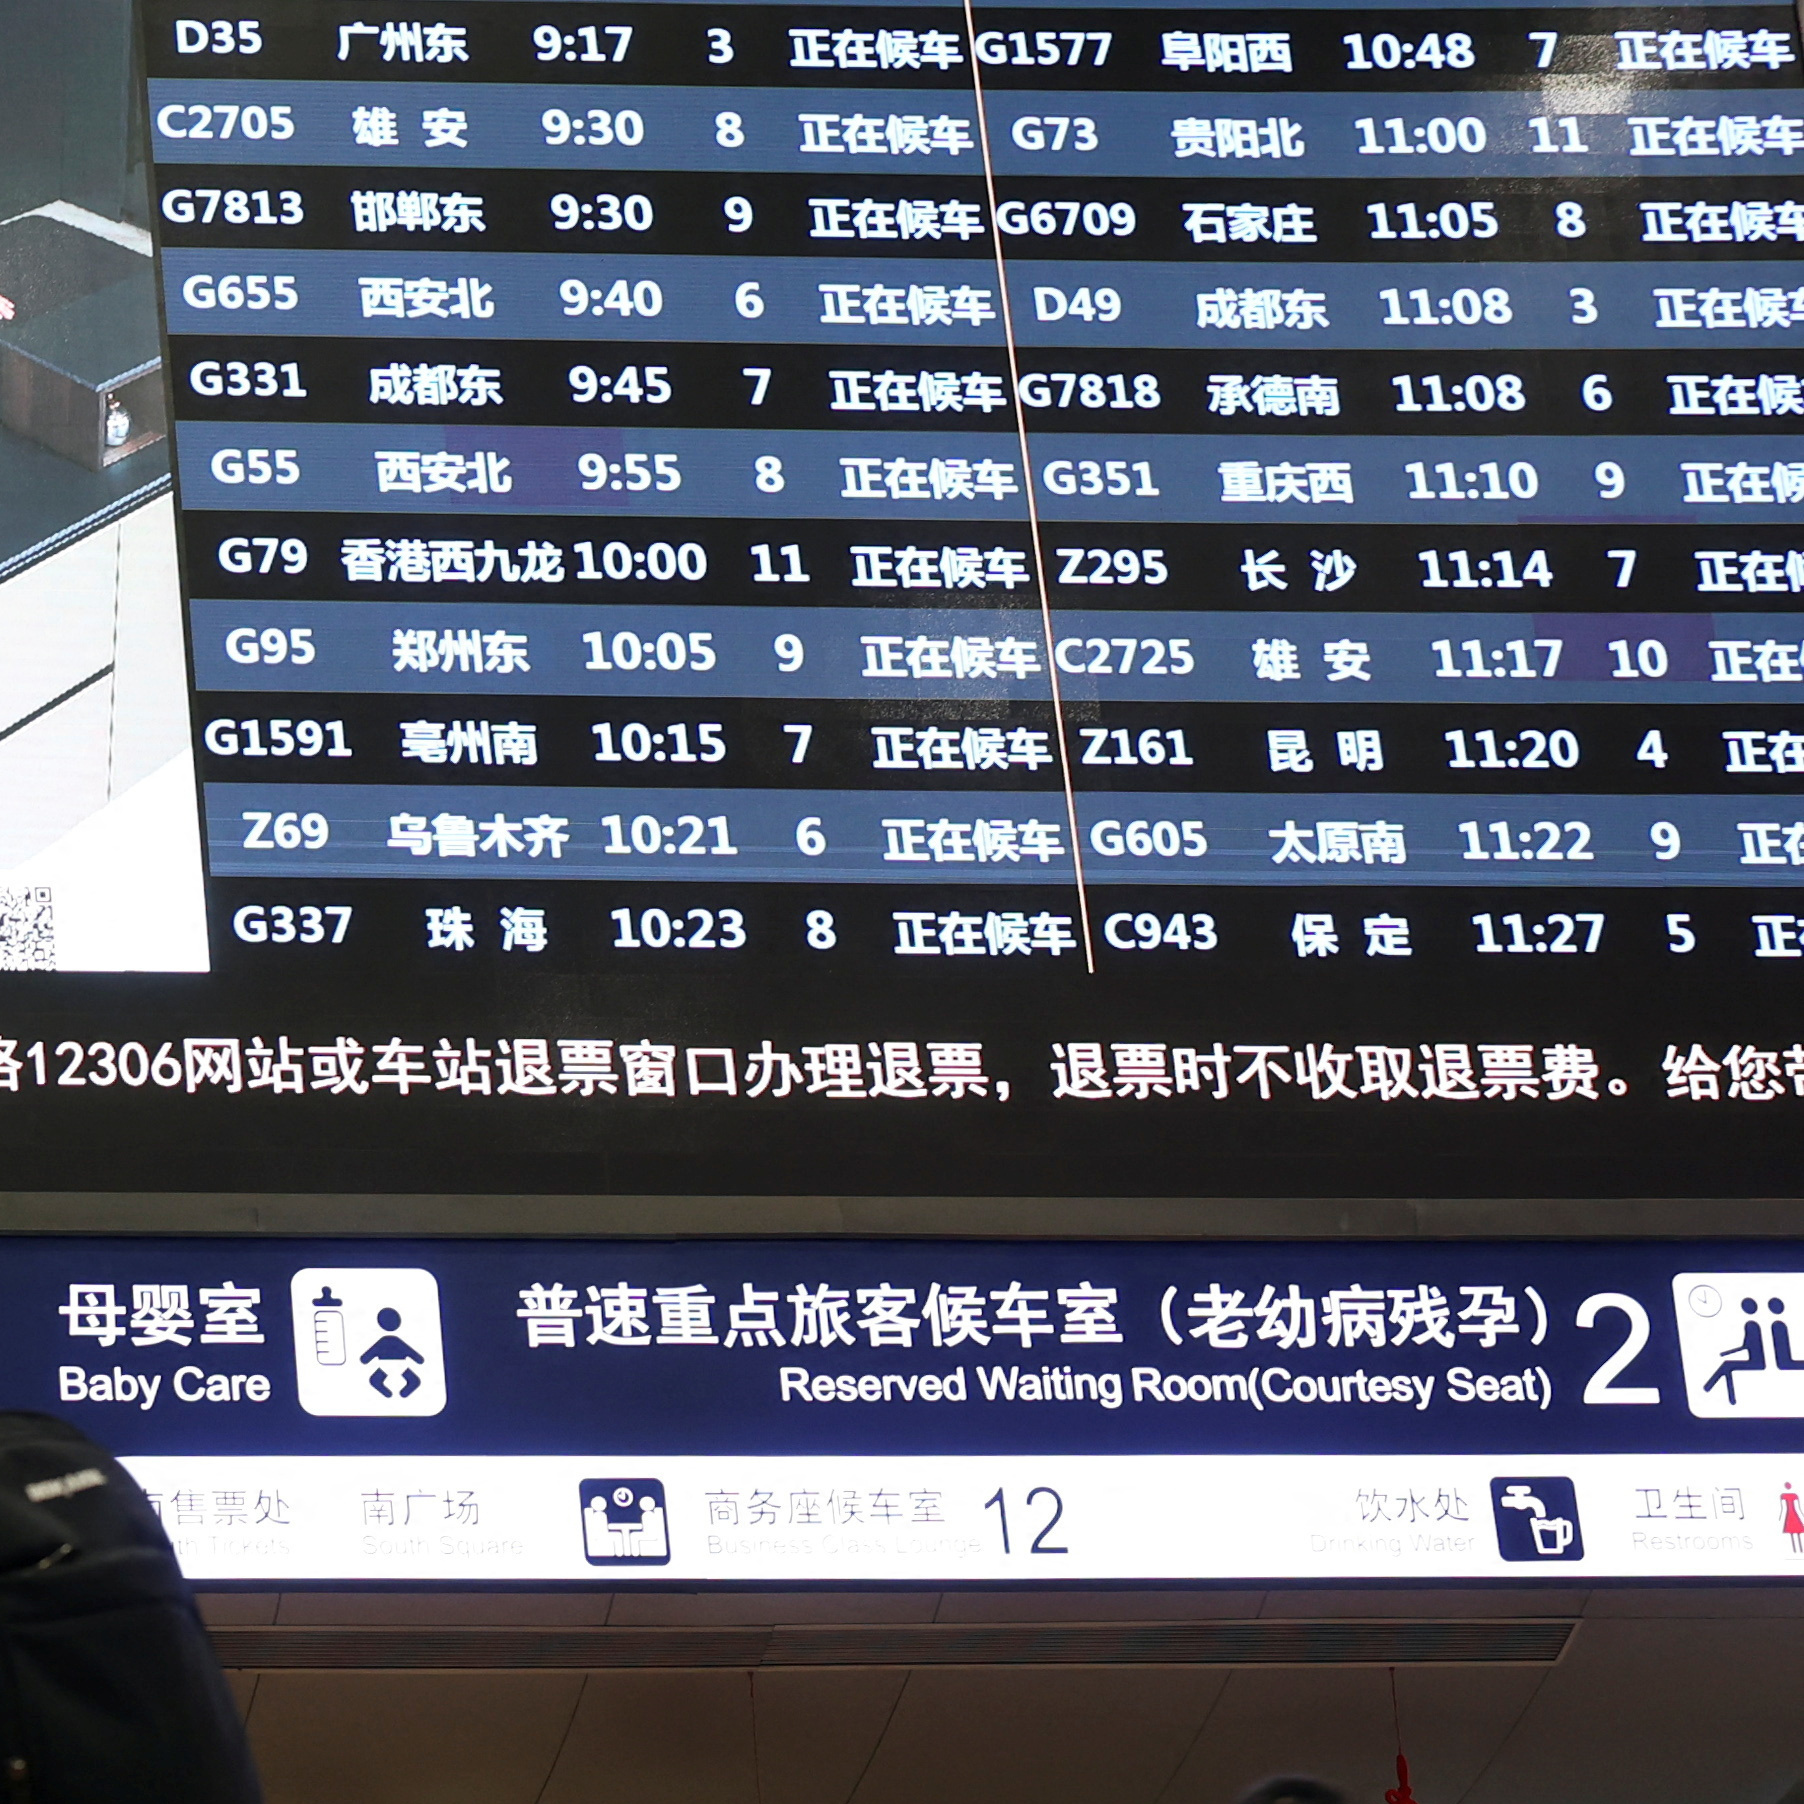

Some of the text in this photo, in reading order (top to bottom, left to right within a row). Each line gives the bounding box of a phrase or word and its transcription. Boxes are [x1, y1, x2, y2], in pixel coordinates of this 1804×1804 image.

[175, 19, 964, 70] D35 广州东 9:17 3 正在候车
[974, 28, 1796, 73] G1577 阜阳西 10:48 7 正在候车
[162, 189, 985, 241] G7813 邯郸东 9:30 9 正在候车
[995, 202, 1138, 239] G6709
[1182, 202, 1318, 243] 石家庄
[1367, 201, 1498, 239] 11:05
[1556, 201, 1586, 238] 8
[218, 537, 1030, 590] G79 香港西九龙 10:00 11 正在候车
[242, 811, 1066, 863] Z69 乌鲁木齐 10:21 6 正在候车
[1090, 819, 1208, 857] G605
[1268, 820, 1407, 865] 太原南
[1458, 820, 1595, 860] 11:22
[1650, 821, 1681, 860] 9
[59, 1282, 264, 1346] 母婴室
[1577, 1293, 1659, 1403] 2
[60, 1366, 270, 1410] Baby Care
[780, 1366, 1551, 1410] Reserved Waiting Room(Courtesy Seat)
[361, 1488, 480, 1526] 南广场
[703, 1487, 1069, 1555] 商务座候车室 12
[1355, 1488, 1470, 1523] 饮水处
[1635, 1487, 1746, 1521] 卫生间
